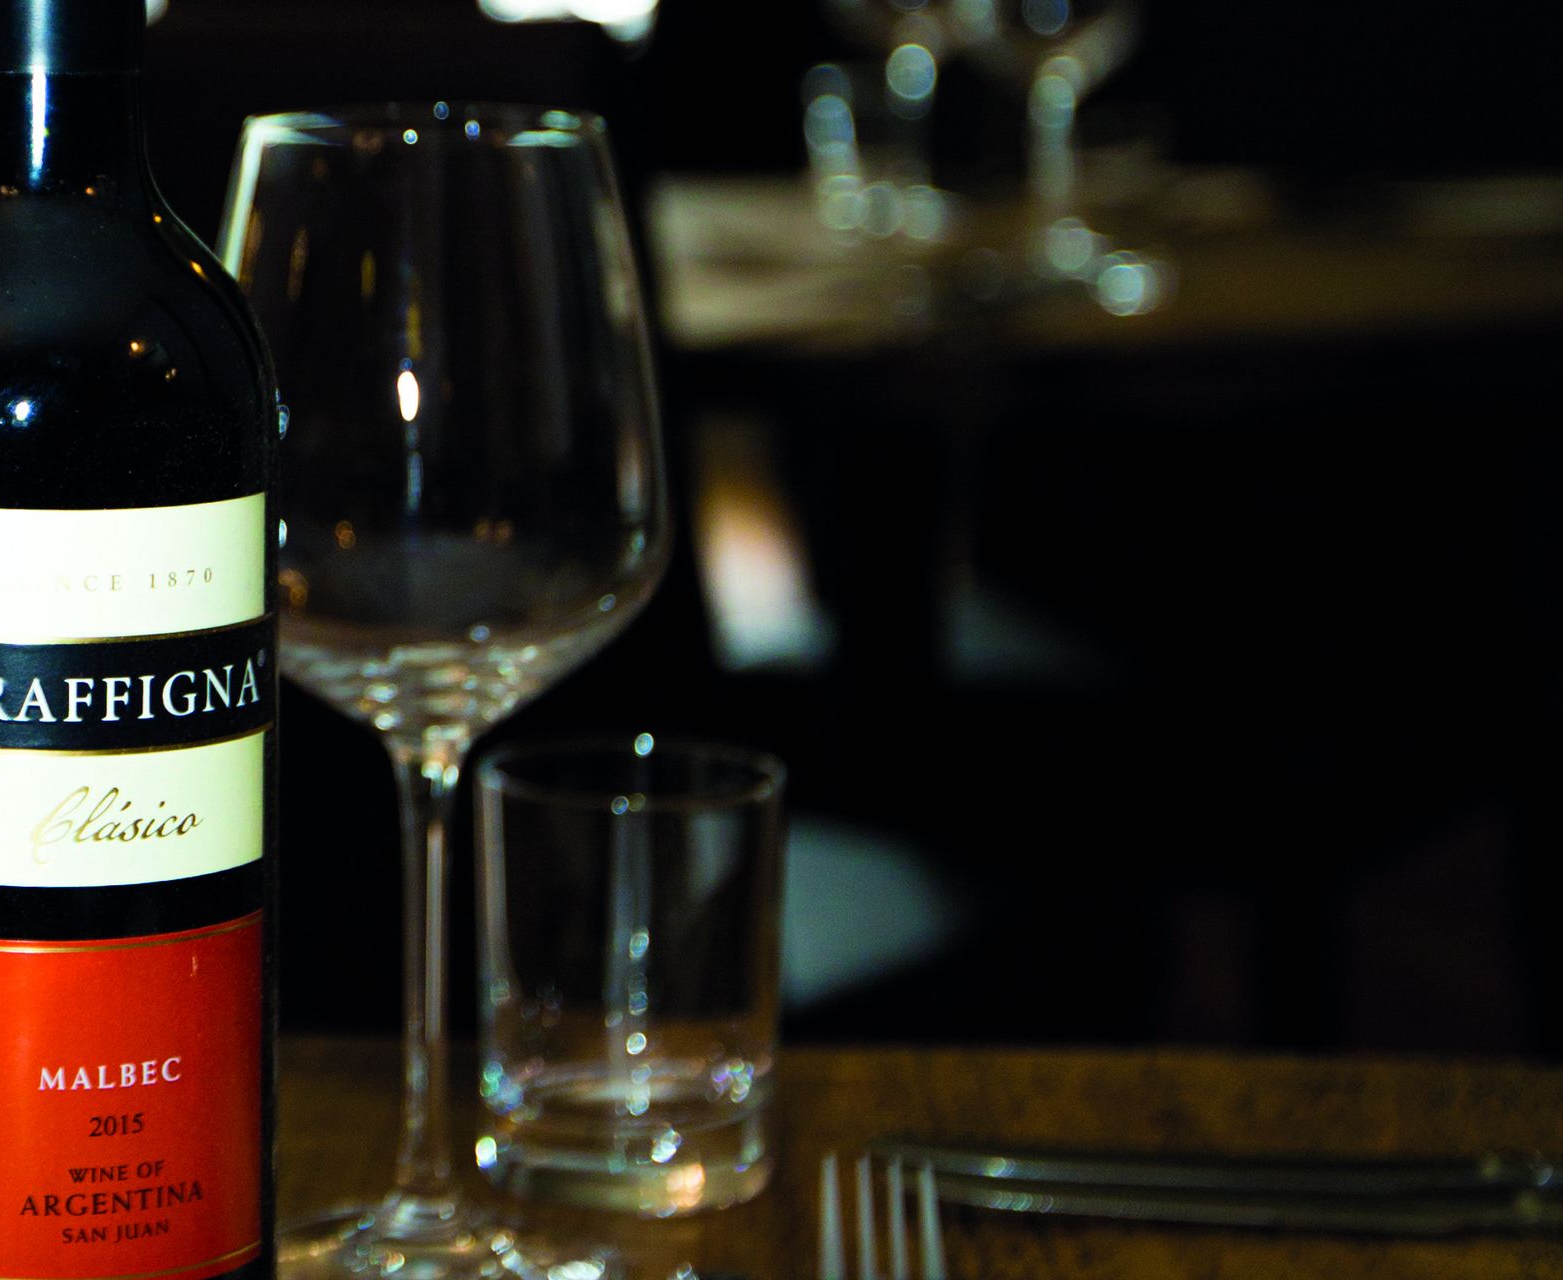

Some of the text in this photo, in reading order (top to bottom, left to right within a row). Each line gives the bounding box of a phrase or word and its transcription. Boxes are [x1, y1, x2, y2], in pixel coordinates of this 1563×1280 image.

[149, 567, 214, 589] 1870
[30, 786, 204, 864] Clásico
[38, 1056, 182, 1091] MALBEC
[88, 1112, 144, 1137] 2015
[68, 1160, 166, 1184] WINE OF
[19, 1179, 205, 1217] ARGENTINA
[61, 1219, 170, 1245] SAN JUAN
